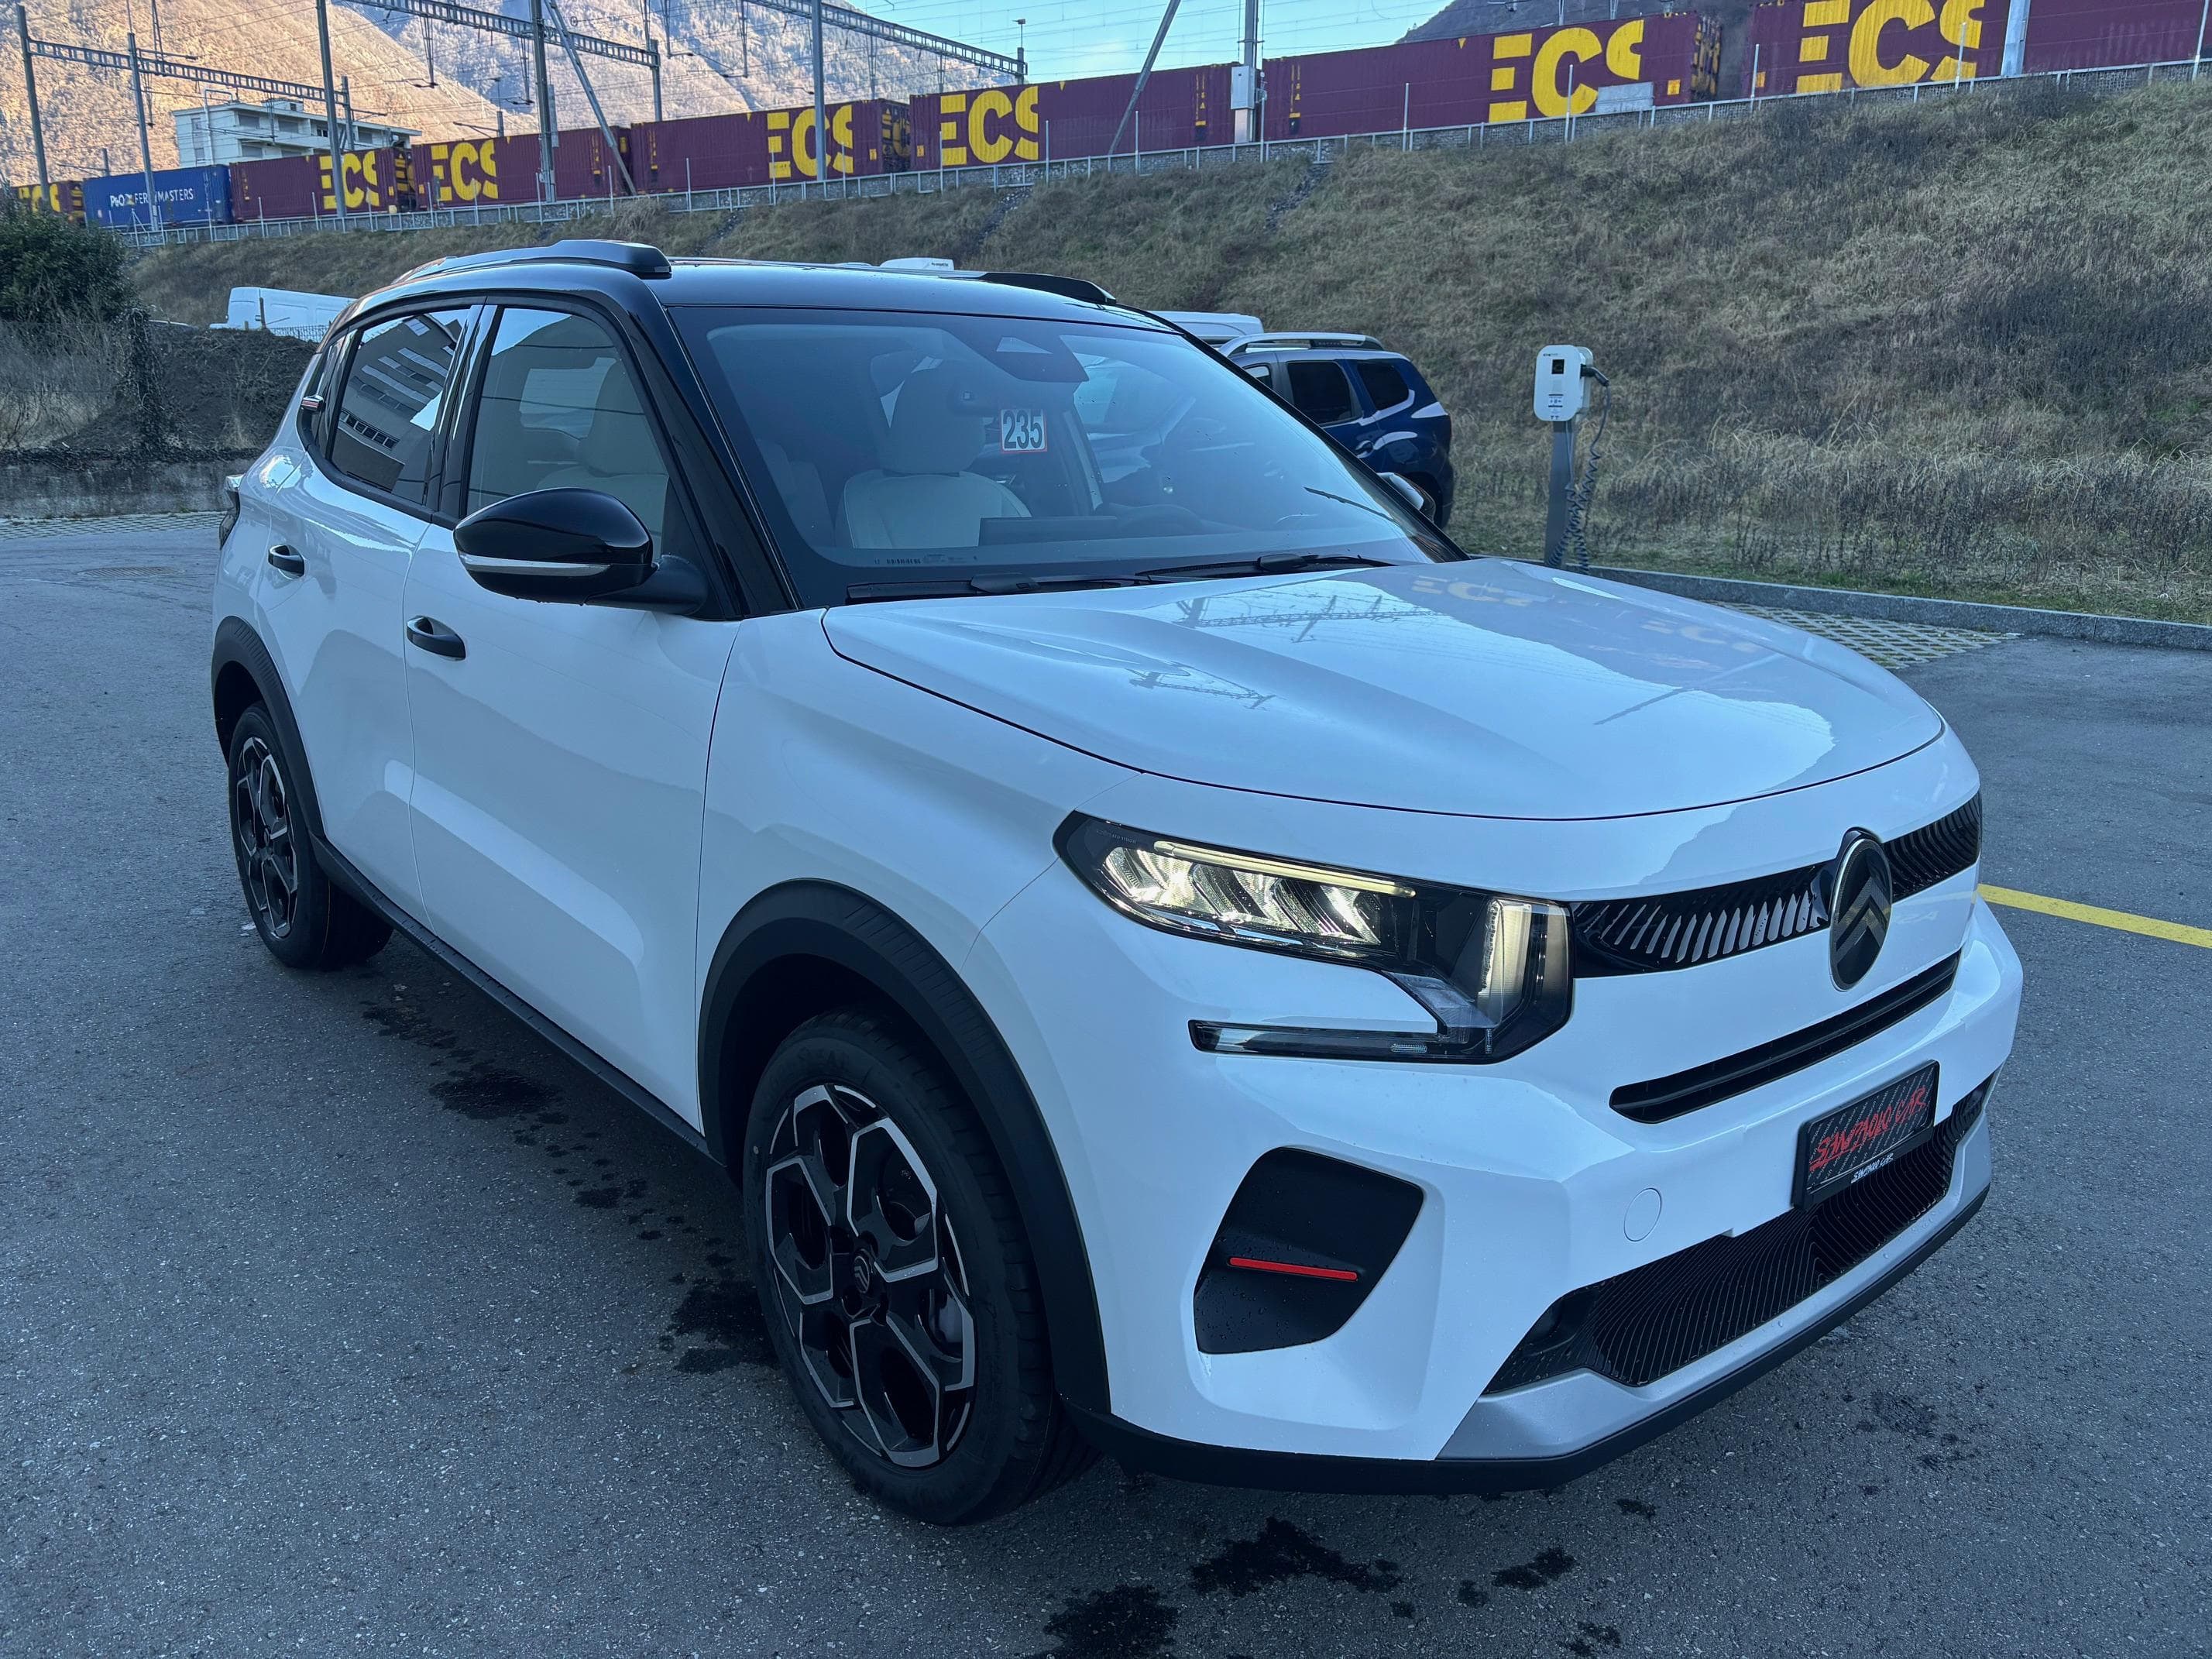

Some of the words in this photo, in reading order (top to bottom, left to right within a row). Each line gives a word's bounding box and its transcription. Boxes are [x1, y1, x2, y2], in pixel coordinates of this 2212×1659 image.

[1489, 19, 1644, 123] ECS
[1796, 0, 1985, 93] ECS
[768, 104, 854, 177] ECS
[940, 86, 1039, 165] ECS
[135, 188, 194, 204] FERMASTERS
[320, 151, 380, 209] ECS
[431, 139, 498, 201] ECS
[1003, 410, 1042, 448] 235
[1895, 1086, 1926, 1123] CAR
